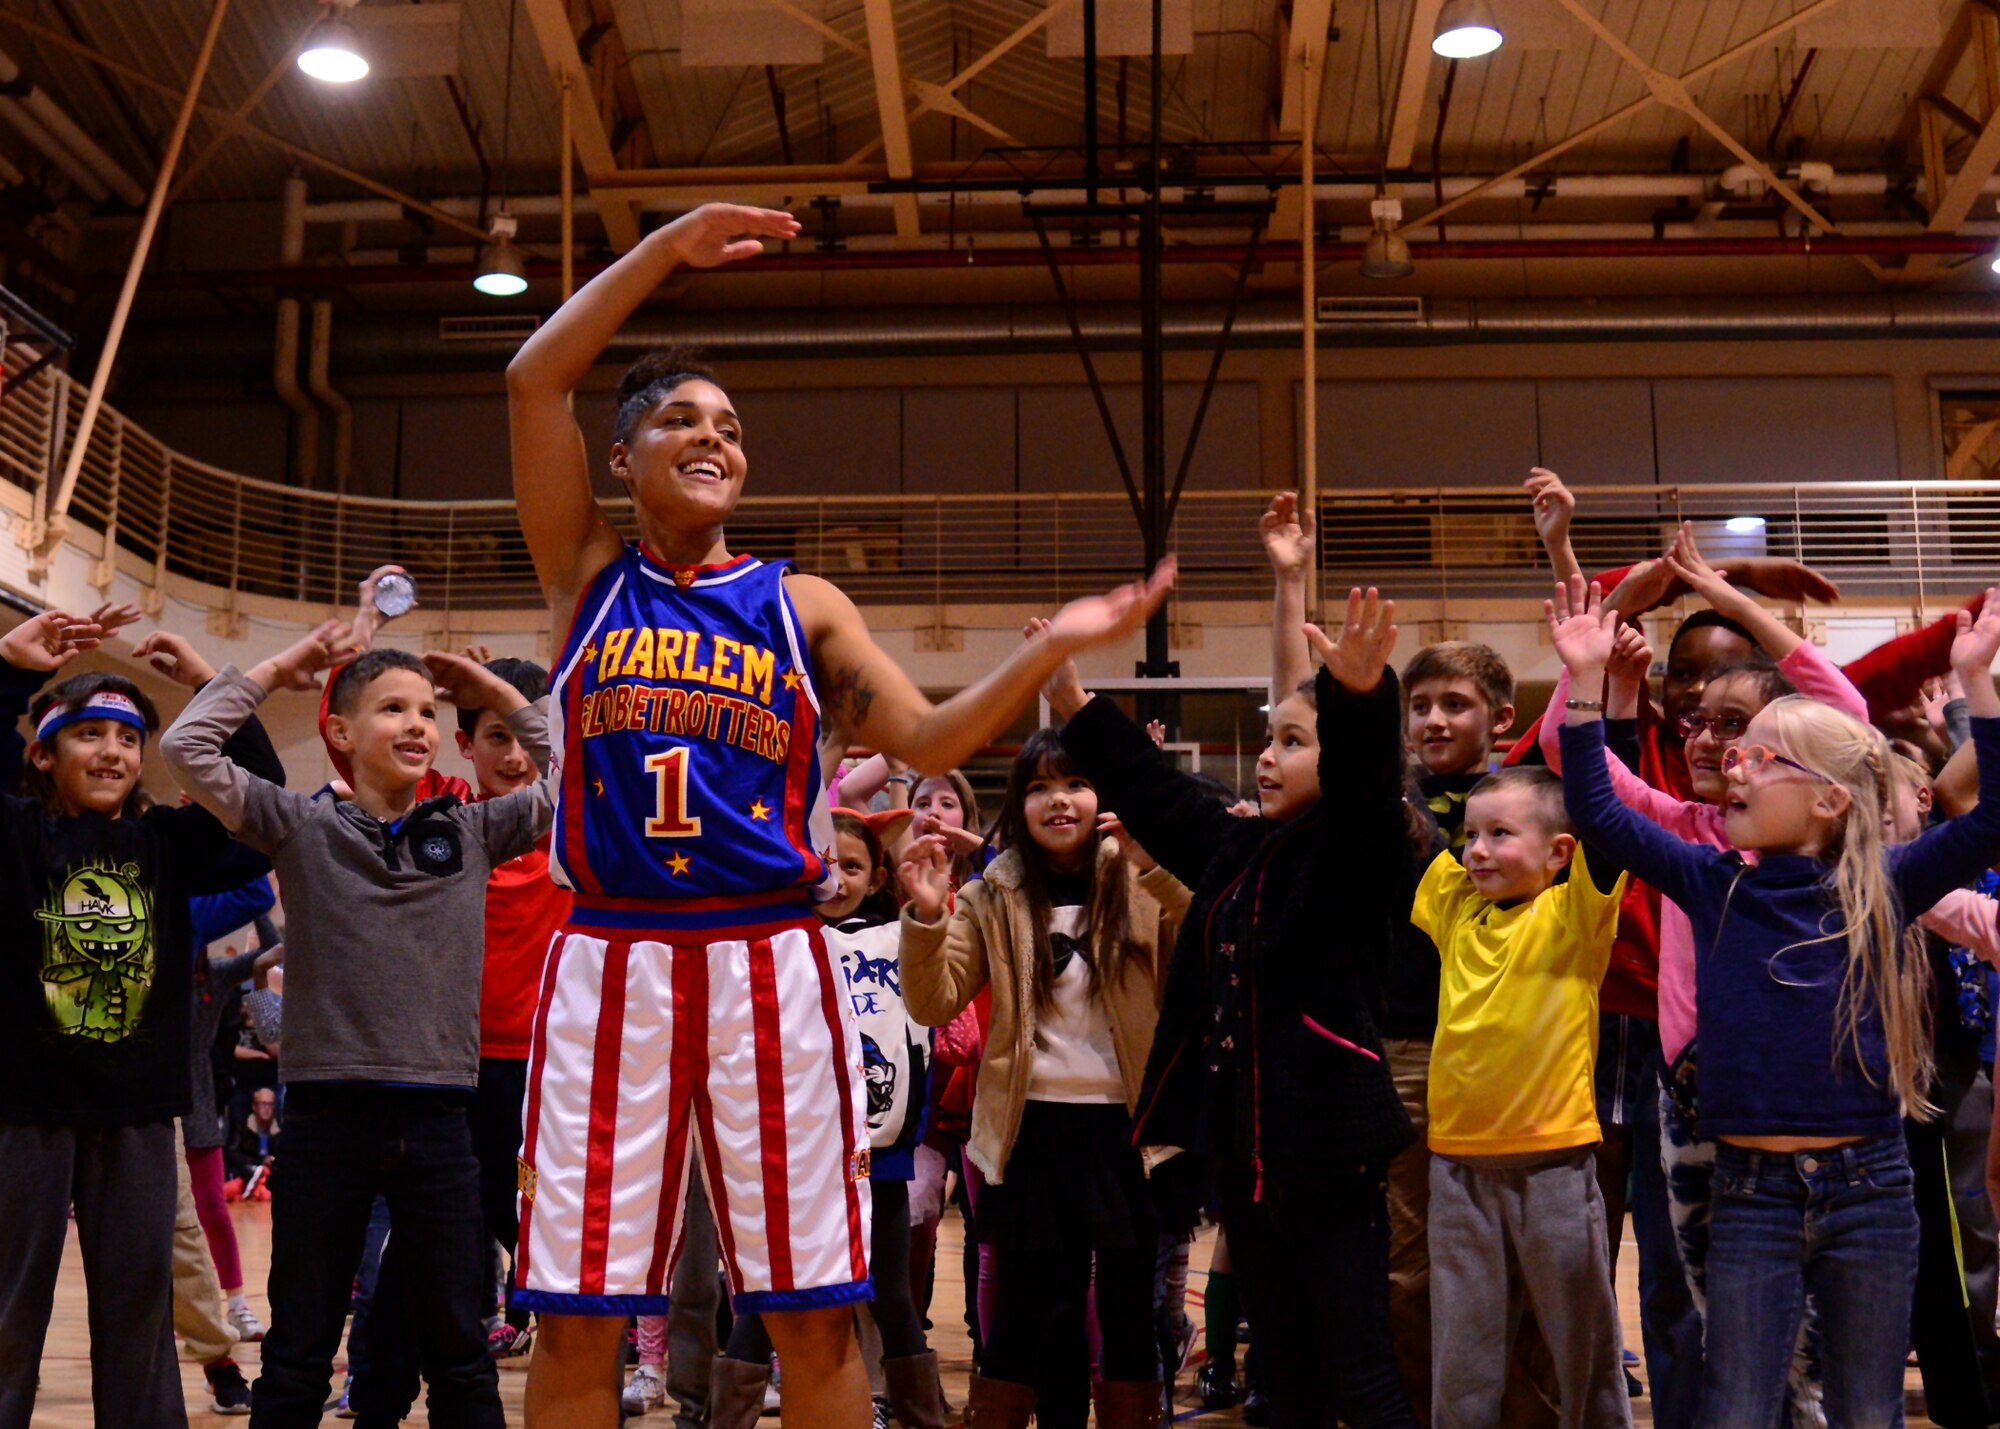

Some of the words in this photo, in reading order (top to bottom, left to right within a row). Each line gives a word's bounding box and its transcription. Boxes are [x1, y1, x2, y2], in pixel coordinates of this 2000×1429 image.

[597, 626, 776, 706] HARLEM
[581, 684, 791, 765] GLOBETROTTERS
[644, 746, 702, 837] 1
[81, 899, 115, 915] HAWK
